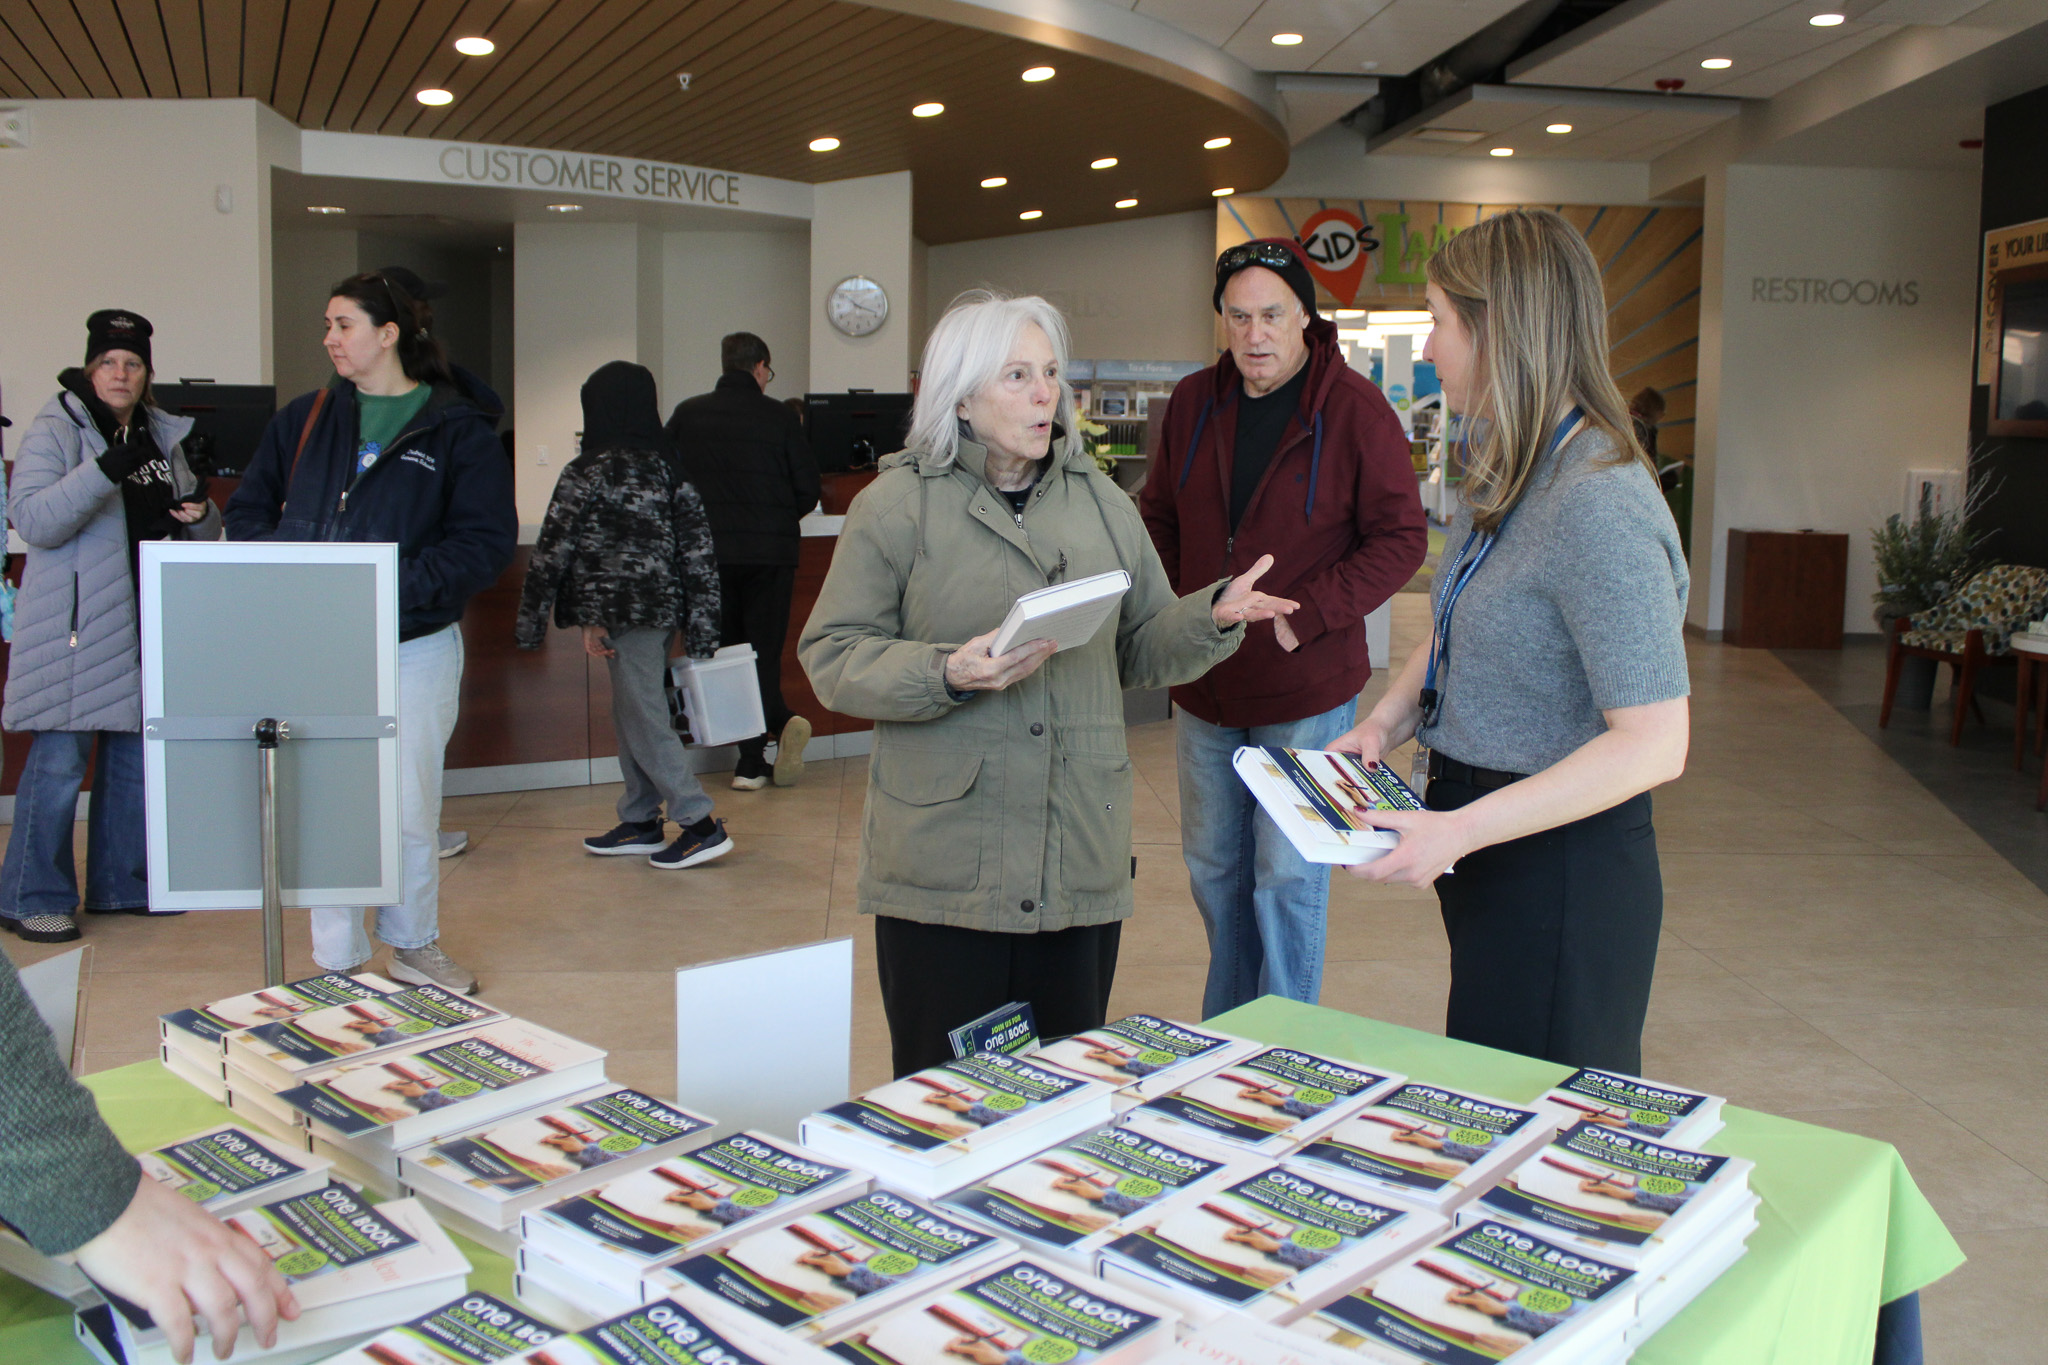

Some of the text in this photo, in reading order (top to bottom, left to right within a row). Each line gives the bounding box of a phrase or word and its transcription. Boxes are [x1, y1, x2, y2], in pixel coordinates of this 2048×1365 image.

[438, 146, 740, 205] CUSTOMER SERVICE
[1294, 224, 1380, 264] KIDS
[2006, 236, 2034, 258] YOUR
[1751, 276, 1919, 306] RESTROOMS
[1128, 363, 1172, 373] Tax Forms
[323, 975, 352, 989] one
[417, 987, 485, 1018] one BOOK
[422, 998, 471, 1020] COMMUNITY
[985, 1033, 1005, 1051] one
[1008, 1020, 1030, 1040] BOOK
[991, 1014, 1022, 1035] JOIN US FOR
[1000, 1032, 1031, 1053] COMMUNITY
[1125, 1015, 1161, 1028] one
[1165, 1027, 1217, 1047] BOOK
[1139, 1026, 1206, 1050] COMMUNITY
[461, 1041, 496, 1057] one
[492, 1056, 538, 1077] BOOK
[467, 1054, 522, 1080] COMMUNITY
[974, 1052, 1012, 1068] one
[1017, 1066, 1073, 1089] BOOK
[1262, 1055, 1288, 1064] one
[1288, 1062, 1364, 1087] COMMUNITY
[1271, 1049, 1310, 1064] one
[1316, 1062, 1374, 1084] BOOK
[988, 1064, 1061, 1093] COMMUNITY
[1579, 1078, 1604, 1088] one
[1606, 1085, 1688, 1108] COMMUNITY
[1584, 1072, 1624, 1088] one
[1635, 1087, 1693, 1104] BOOK
[615, 1092, 651, 1109] one
[649, 1108, 697, 1132] BOOK
[622, 1106, 682, 1134] COMMUNITY
[1399, 1092, 1426, 1101] one
[1428, 1099, 1516, 1125] COMMUNITY
[1405, 1085, 1449, 1101] one
[1460, 1100, 1522, 1121] BOOK
[199, 1139, 219, 1151] one
[215, 1149, 269, 1181] COMMUNITY
[214, 1132, 248, 1152] one
[242, 1152, 288, 1177] BOOK
[718, 1144, 744, 1157] one
[742, 1156, 819, 1184] COMMUNITY
[730, 1137, 772, 1158] one
[774, 1156, 833, 1179] BOOK
[1087, 1135, 1114, 1146] one
[1115, 1143, 1197, 1176] COMMUNITY
[1097, 1128, 1141, 1146] one
[1146, 1145, 1208, 1172] BOOK
[1577, 1133, 1608, 1147] one
[1610, 1144, 1706, 1171] COMMUNITY
[1584, 1126, 1632, 1147] one
[1644, 1146, 1712, 1167] BOOK
[1258, 1178, 1287, 1194] one
[1288, 1191, 1377, 1226] COMMUNITY
[1268, 1172, 1314, 1195] one
[1322, 1194, 1389, 1222] BOOK
[307, 1195, 329, 1212] one
[323, 1210, 380, 1252] COMMUNITY
[322, 1188, 358, 1214] one
[351, 1215, 400, 1248] BOOK
[857, 1201, 962, 1251] one COMMUNITY
[870, 1194, 980, 1247] one BOOK
[1472, 1231, 1505, 1249] one
[1506, 1245, 1606, 1287] COMMUNITY
[1482, 1224, 1534, 1251] one
[1543, 1249, 1618, 1281] BOOK
[463, 1298, 513, 1326] one
[1000, 1275, 1123, 1334] one COMMUNITY
[1013, 1266, 1140, 1329] one BOOK
[448, 1307, 478, 1325] one
[629, 1314, 664, 1340] one
[648, 1306, 701, 1344] one
